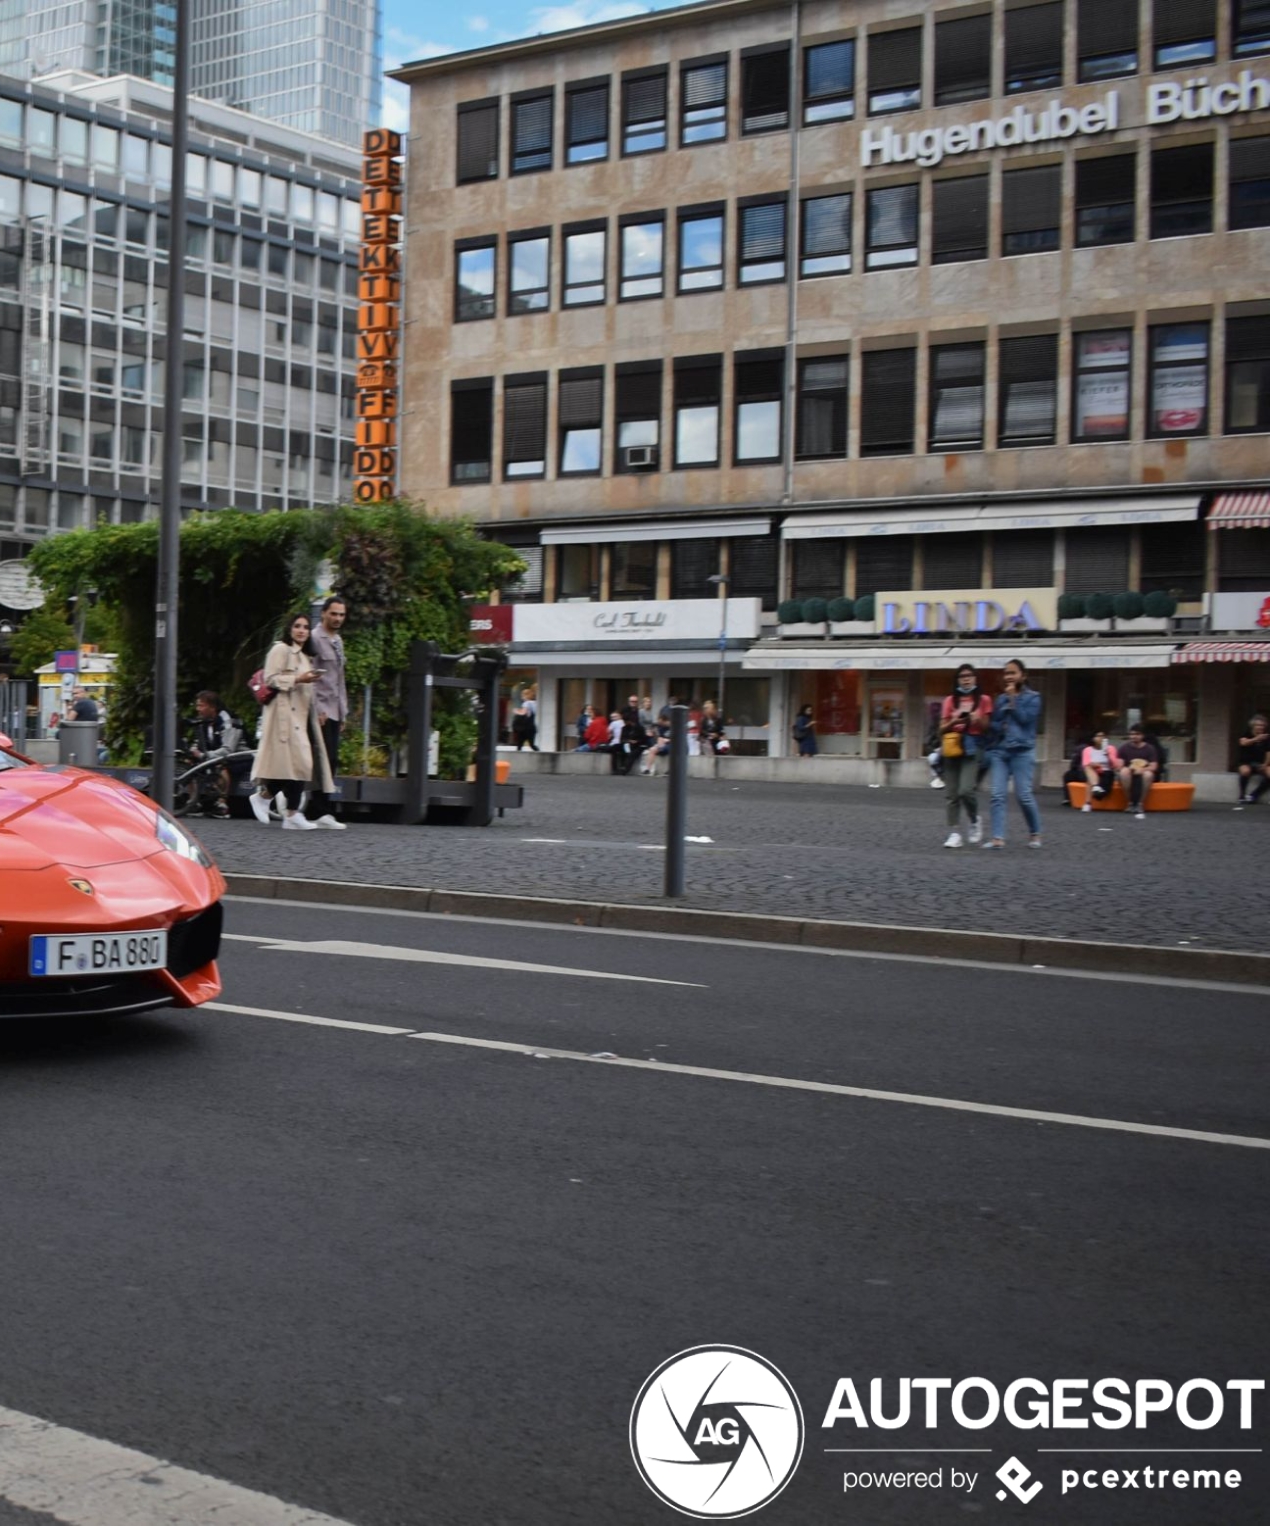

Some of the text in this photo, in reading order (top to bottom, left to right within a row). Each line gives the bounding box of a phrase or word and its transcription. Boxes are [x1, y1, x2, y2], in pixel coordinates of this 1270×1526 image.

[860, 89, 1119, 167] Hugendubel
[362, 131, 385, 355] DETEKTIV
[358, 393, 378, 502] FIDO
[882, 600, 1046, 634] LINDA
[58, 936, 160, 970] F BA 880
